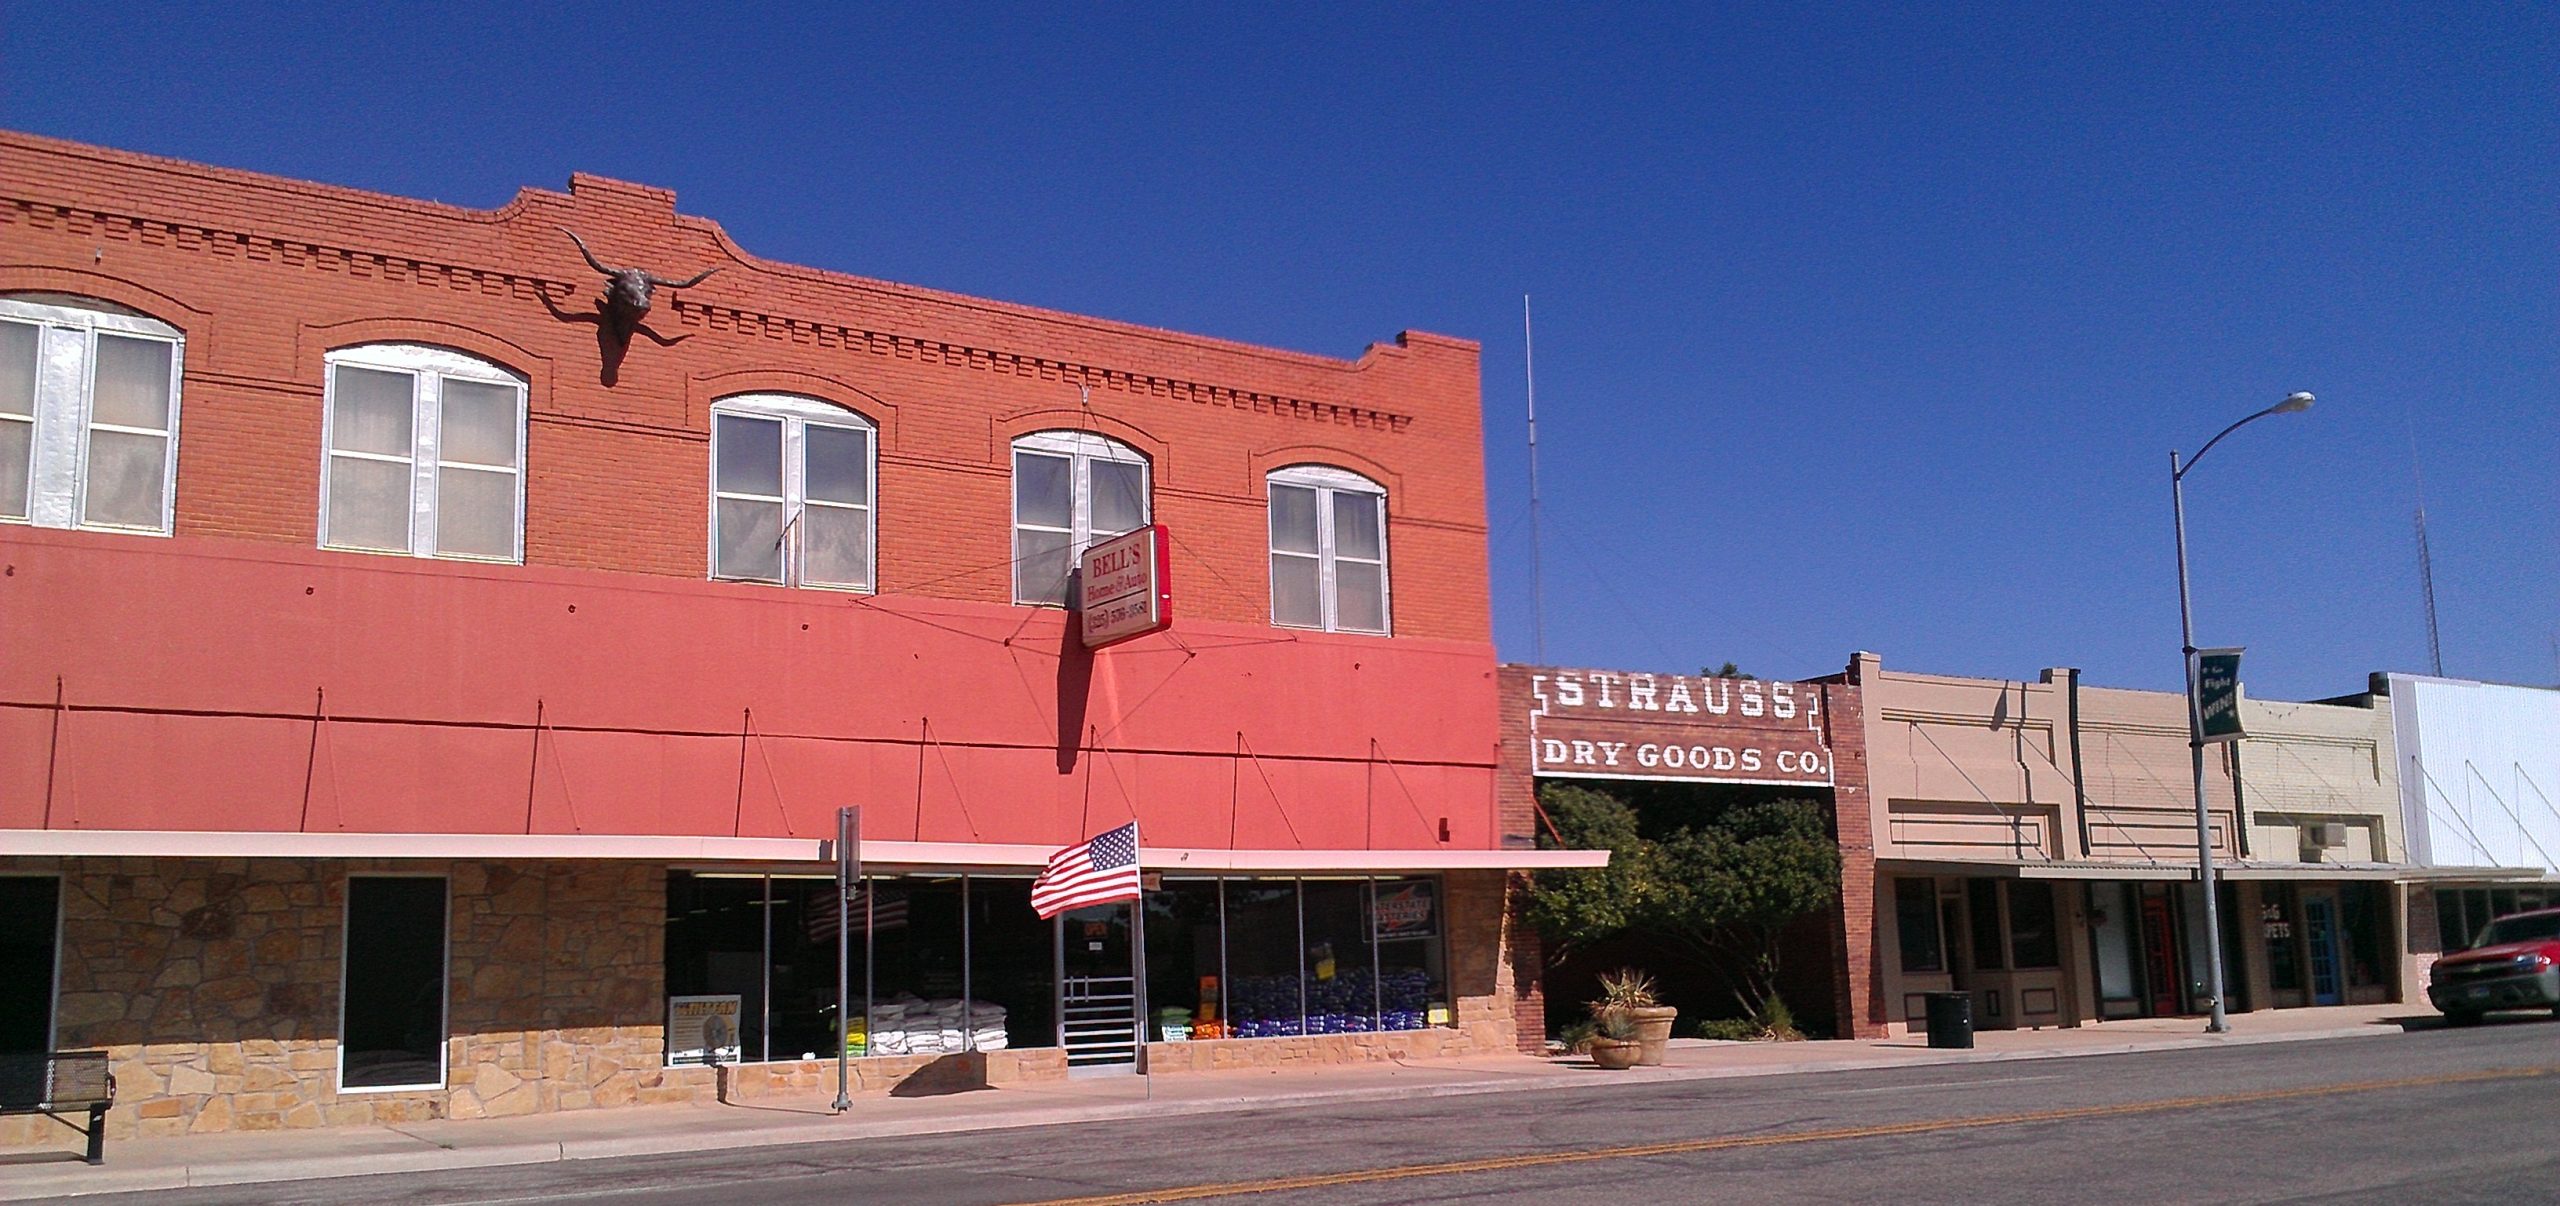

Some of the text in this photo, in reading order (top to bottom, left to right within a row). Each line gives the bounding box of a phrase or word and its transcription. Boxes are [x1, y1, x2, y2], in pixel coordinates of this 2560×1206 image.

[1092, 543, 1141, 578] BELL'S
[1087, 583, 1115, 602] Home
[1124, 572, 1148, 590] Auto
[1554, 673, 1797, 718] STRAUSS
[2205, 677, 2230, 690] Fight
[1542, 739, 1828, 775] DRY GOODS CO.
[1366, 897, 1432, 915] ITERSTATE
